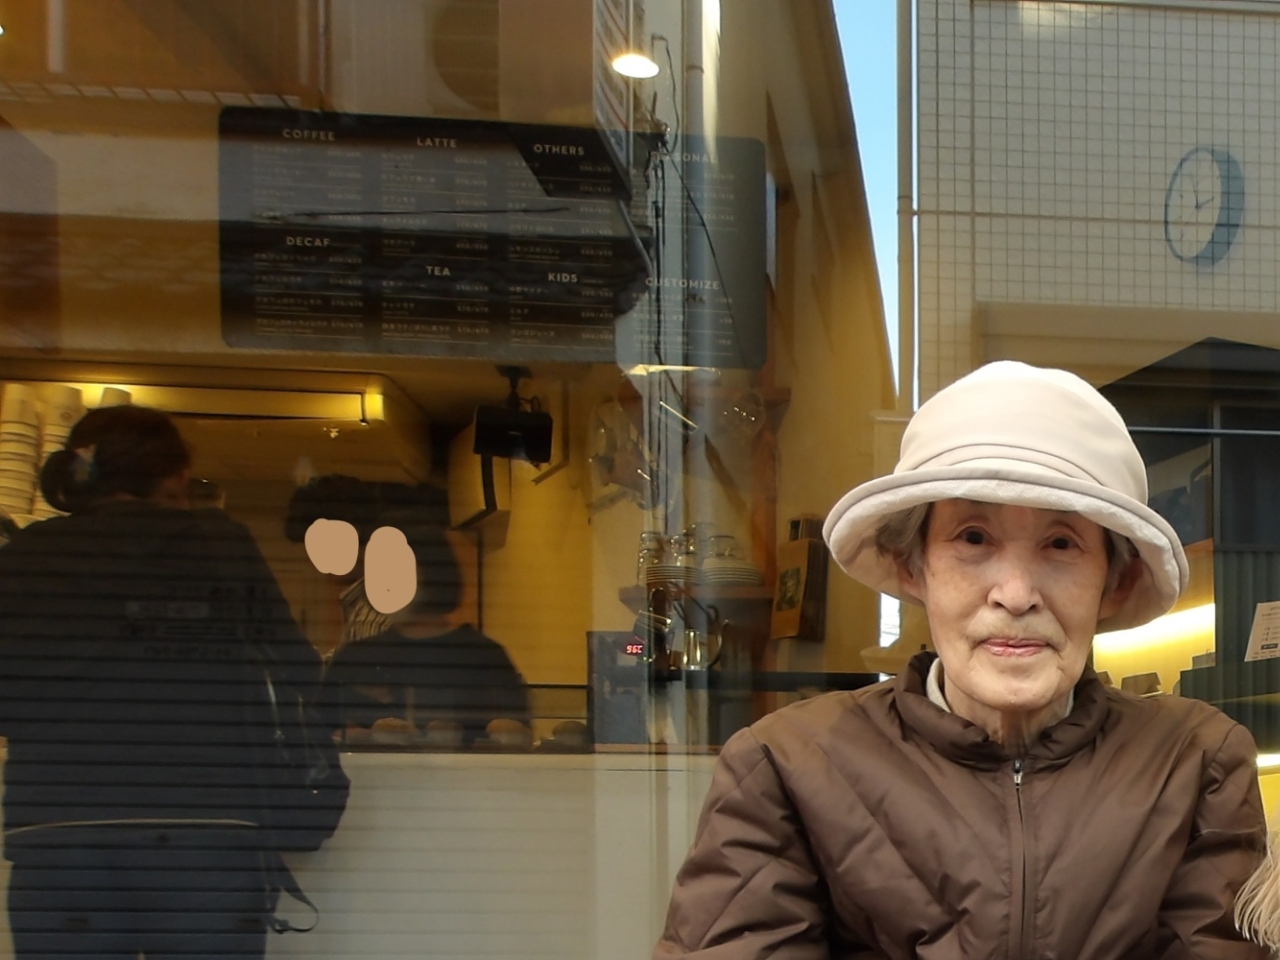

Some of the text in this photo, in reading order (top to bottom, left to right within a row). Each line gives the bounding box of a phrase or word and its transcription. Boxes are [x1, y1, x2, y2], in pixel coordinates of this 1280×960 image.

[282, 128, 335, 142] COFFEE
[416, 137, 458, 148] LATTE
[533, 143, 585, 156] OTHERS
[285, 236, 330, 247] DECAF
[425, 265, 451, 277] TEA
[547, 272, 578, 284] KIDS
[645, 277, 720, 290] CUSTOMIZE
